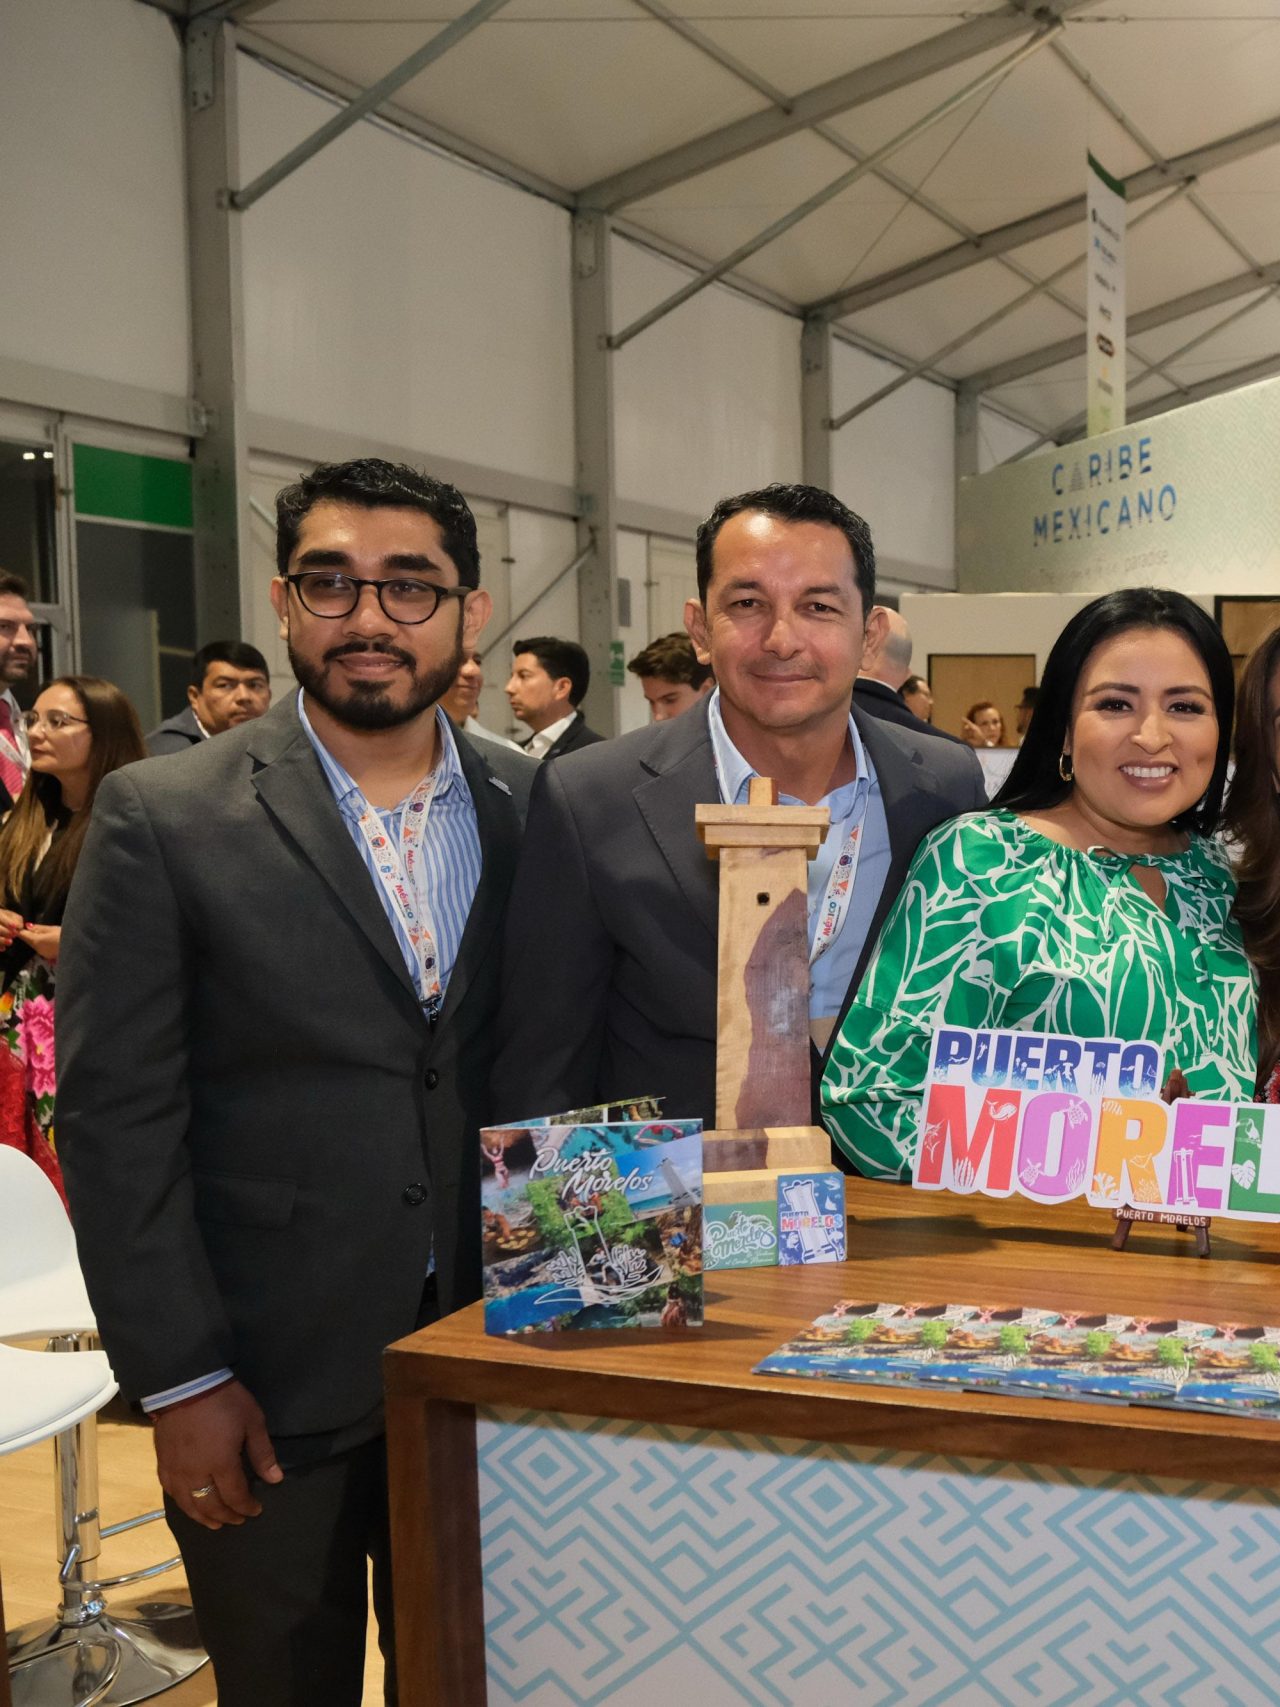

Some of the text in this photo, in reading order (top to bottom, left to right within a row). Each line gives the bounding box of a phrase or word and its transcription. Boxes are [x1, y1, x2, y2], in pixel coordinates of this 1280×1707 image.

[1052, 437, 1152, 496] CARIBE
[1033, 483, 1177, 547] MEXICANO
[933, 1030, 1159, 1097] PUERTO
[529, 1147, 614, 1179] Puerto
[562, 1167, 652, 1203] Morelos
[1116, 1208, 1206, 1227] PUERTO MORELOS
